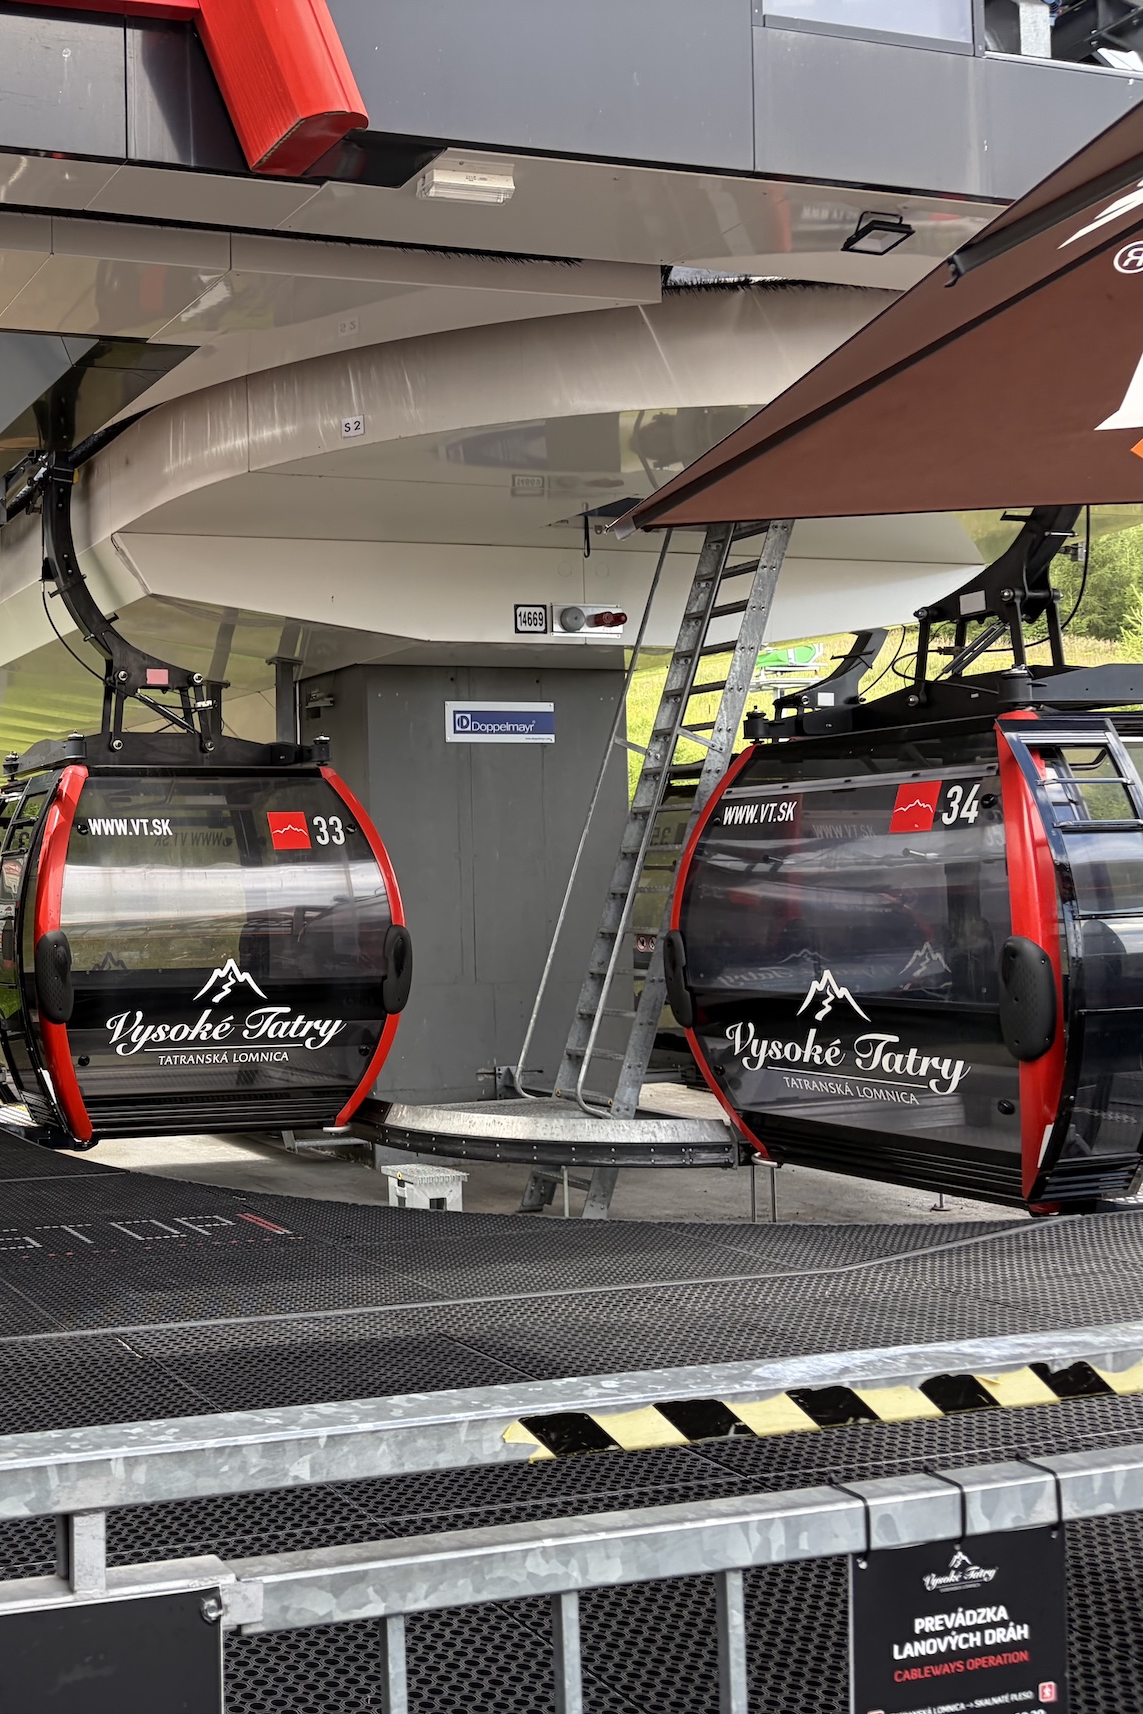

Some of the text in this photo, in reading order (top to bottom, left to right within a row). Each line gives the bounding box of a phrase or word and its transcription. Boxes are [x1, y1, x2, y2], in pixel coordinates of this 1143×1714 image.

[344, 420, 361, 433] S 2
[518, 611, 544, 627] 14669
[471, 720, 535, 734] Doppelmayr
[723, 801, 798, 826] WWW.VT.SK
[942, 783, 981, 825] 34
[88, 818, 173, 836] WWW.VT.SK
[312, 815, 347, 846] 33
[106, 1006, 347, 1056] Vysoké Tatry
[158, 1051, 289, 1066] TATRANSKÁ LOMNICA
[726, 1022, 971, 1095] Vysoké Tatry
[783, 1076, 920, 1105] TATRANSKÁ LOMNICA
[922, 1569, 963, 1591] Vysoké
[963, 1566, 997, 1582] Tatry
[914, 1605, 1009, 1634] PREVÁDZKA
[892, 1621, 1029, 1660] LANOVÝCH DRÁH
[893, 1650, 1030, 1683] CABLEWAYS OPERATION
